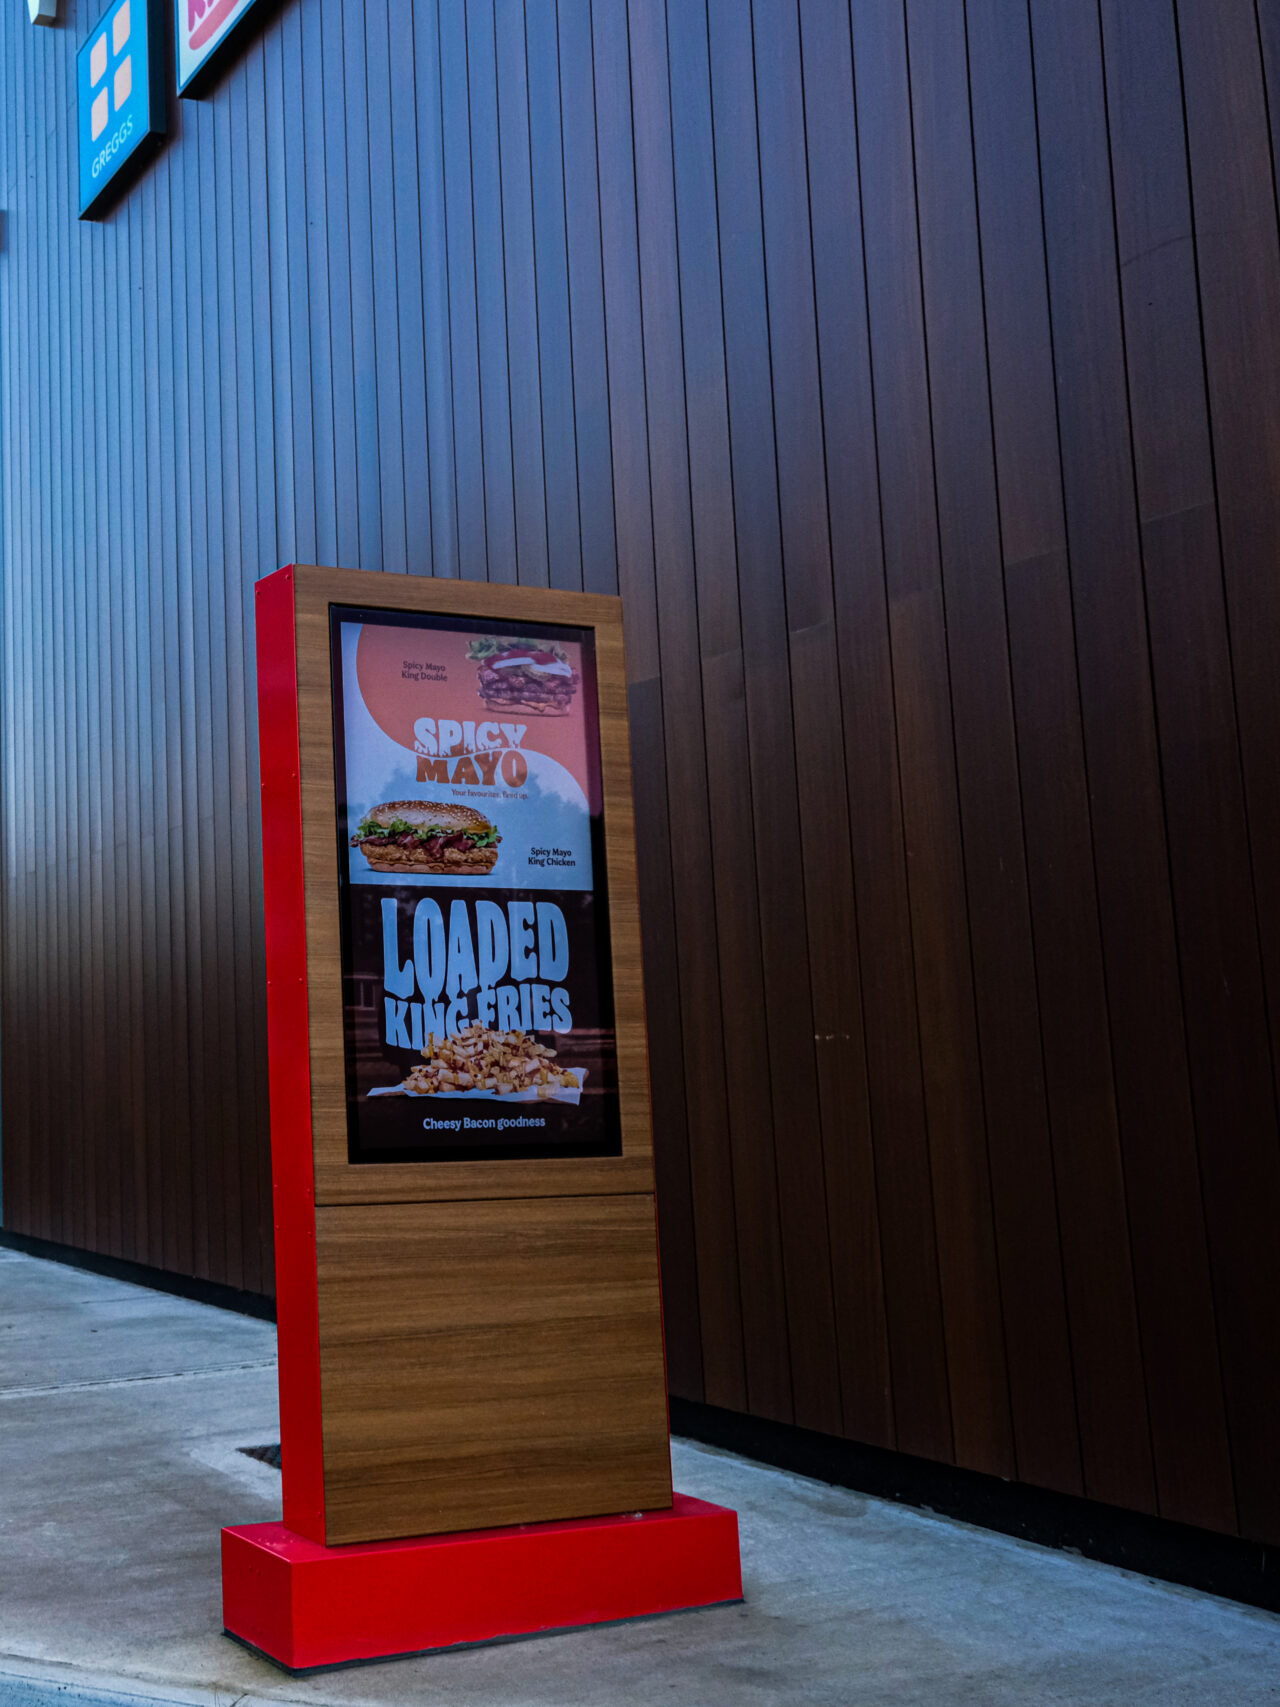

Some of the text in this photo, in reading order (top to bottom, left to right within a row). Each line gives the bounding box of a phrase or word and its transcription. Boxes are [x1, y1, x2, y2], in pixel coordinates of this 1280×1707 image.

[91, 114, 133, 178] GREGGS
[401, 670, 448, 682] King Double
[402, 660, 446, 672] Spicy Mayo
[413, 717, 527, 756] SPICY
[415, 749, 528, 788] MAYO
[528, 856, 576, 867] King Chicken
[530, 847, 572, 858] Spicy Mayo
[381, 897, 570, 999] LOADED
[384, 983, 572, 1050] KING FRIES
[423, 1116, 546, 1131] Cheesy Bacon goodness
